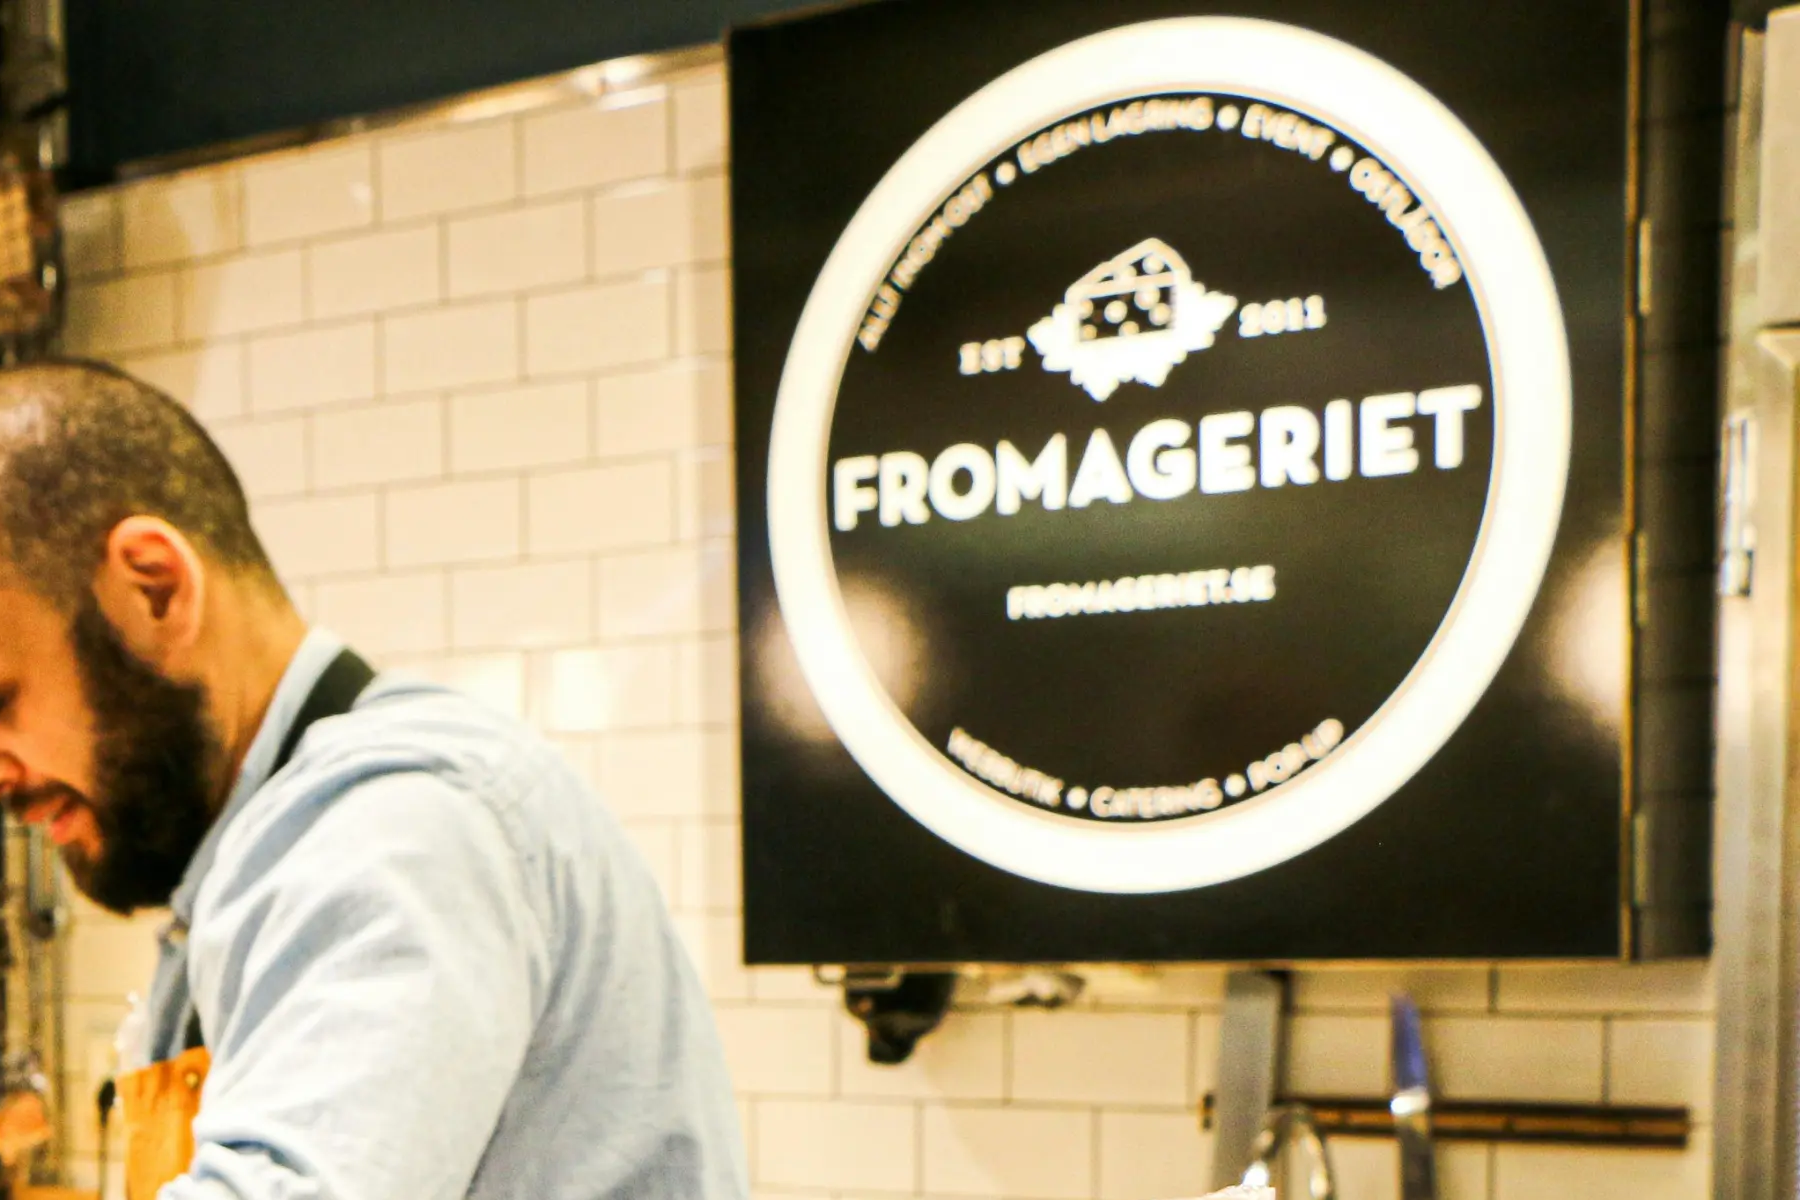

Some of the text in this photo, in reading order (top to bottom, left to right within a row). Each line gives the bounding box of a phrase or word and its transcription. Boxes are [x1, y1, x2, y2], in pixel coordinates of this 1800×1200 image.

[1241, 103, 1336, 161] EVENT
[1239, 294, 1327, 338] 2011
[833, 383, 1482, 532] FROMAGERIET
[1006, 564, 1276, 621] FROMAGERIET.SE
[1090, 777, 1223, 819] CATERING
